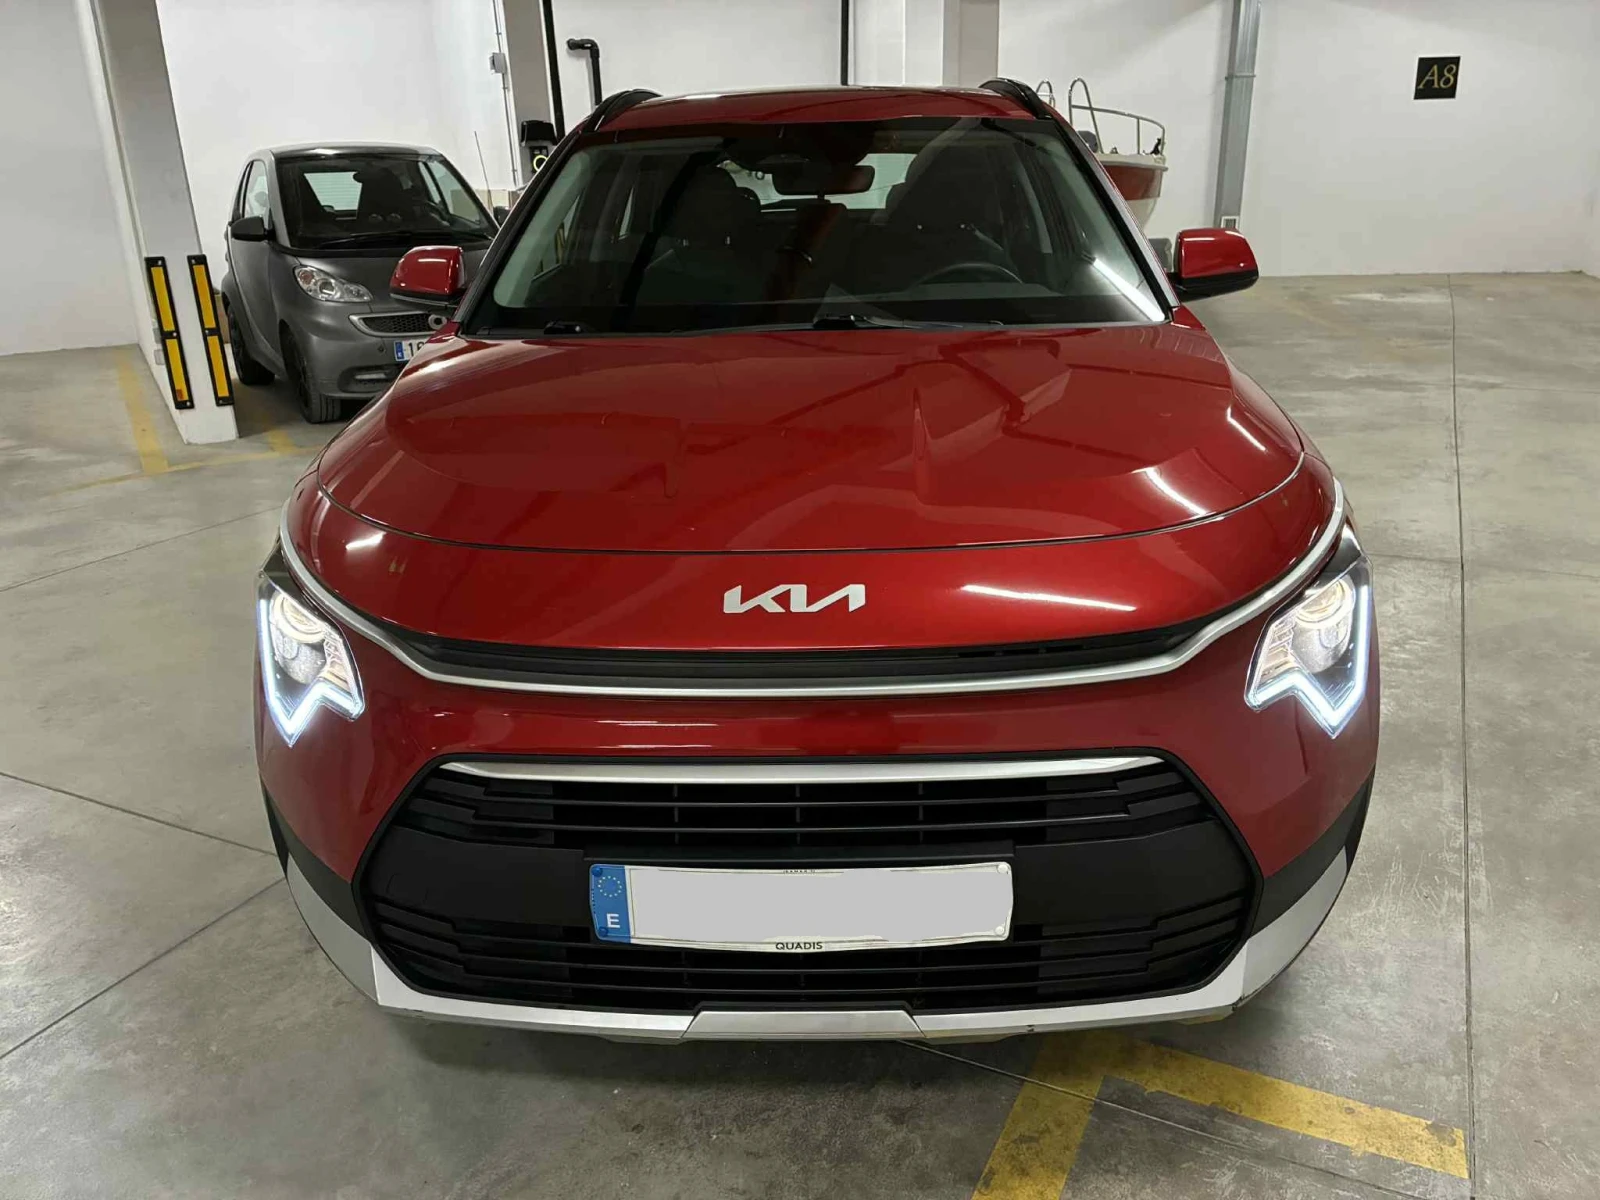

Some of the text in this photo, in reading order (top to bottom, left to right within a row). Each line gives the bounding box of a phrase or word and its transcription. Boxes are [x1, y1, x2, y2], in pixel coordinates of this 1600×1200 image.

[1417, 64, 1456, 88] A8
[723, 584, 866, 613] KIA
[606, 913, 621, 929] E
[775, 941, 823, 950] QUADIS
